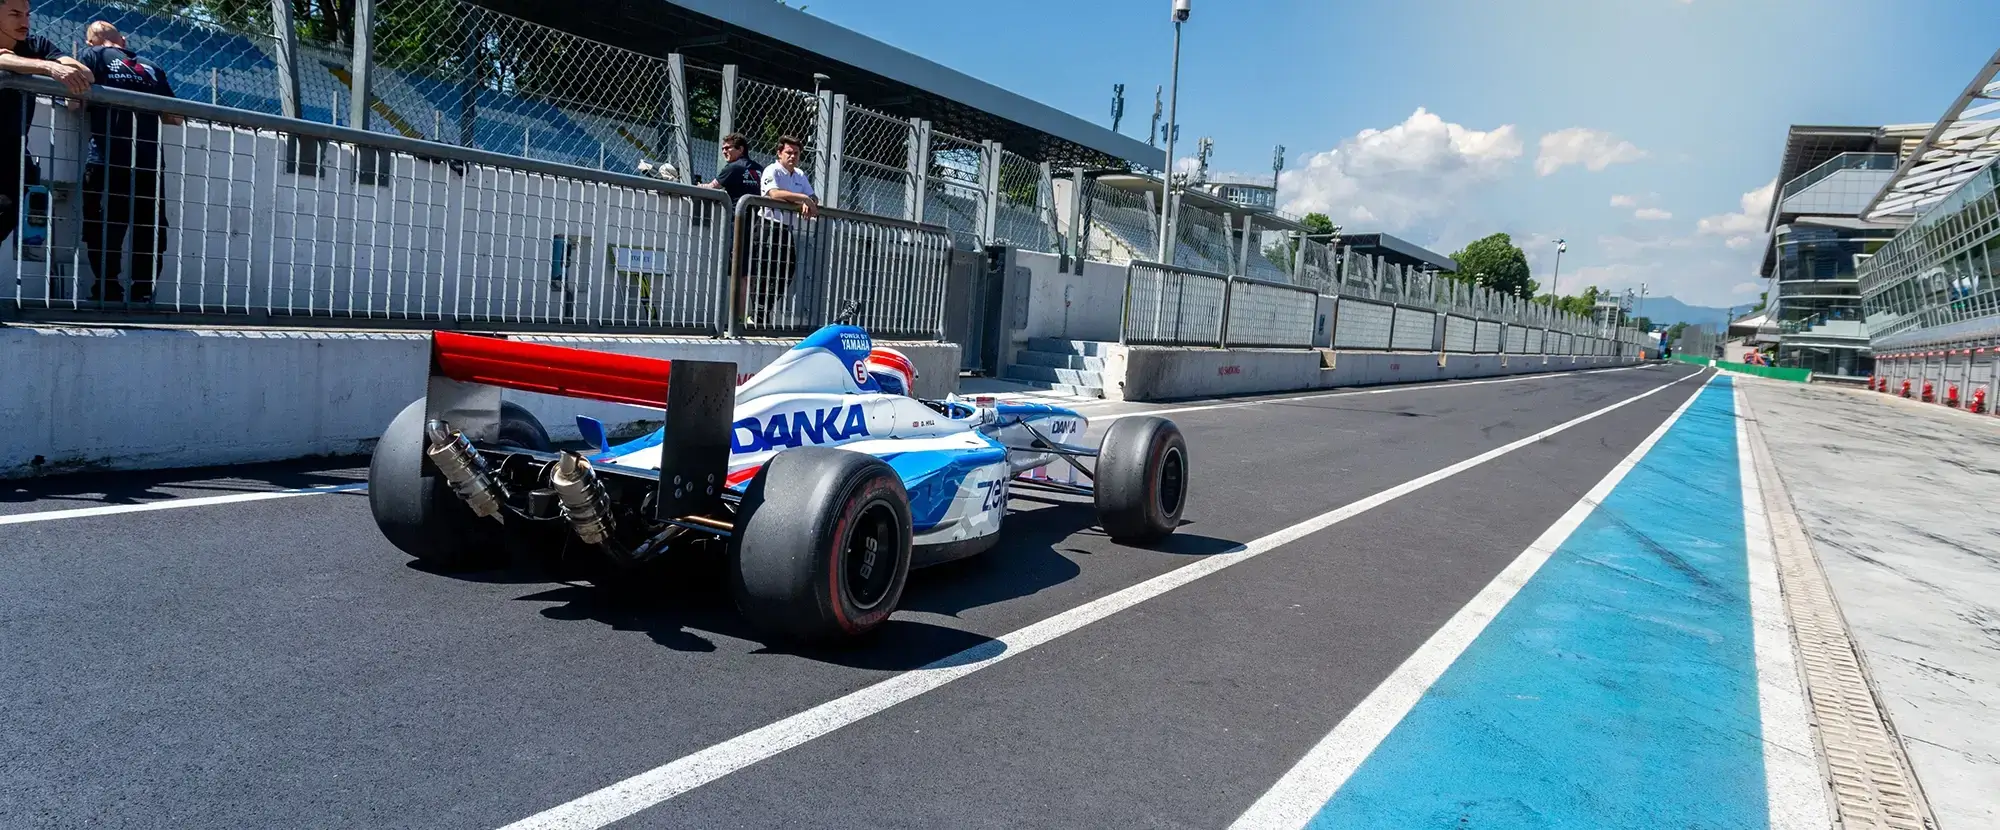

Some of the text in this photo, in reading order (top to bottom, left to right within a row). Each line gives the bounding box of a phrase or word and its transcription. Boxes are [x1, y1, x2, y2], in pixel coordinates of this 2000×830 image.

[841, 339, 870, 351] YAMAHA
[856, 364, 865, 381] E
[731, 403, 870, 454] DANKA
[1051, 420, 1077, 434] DANKA
[860, 536, 878, 580] BBS
